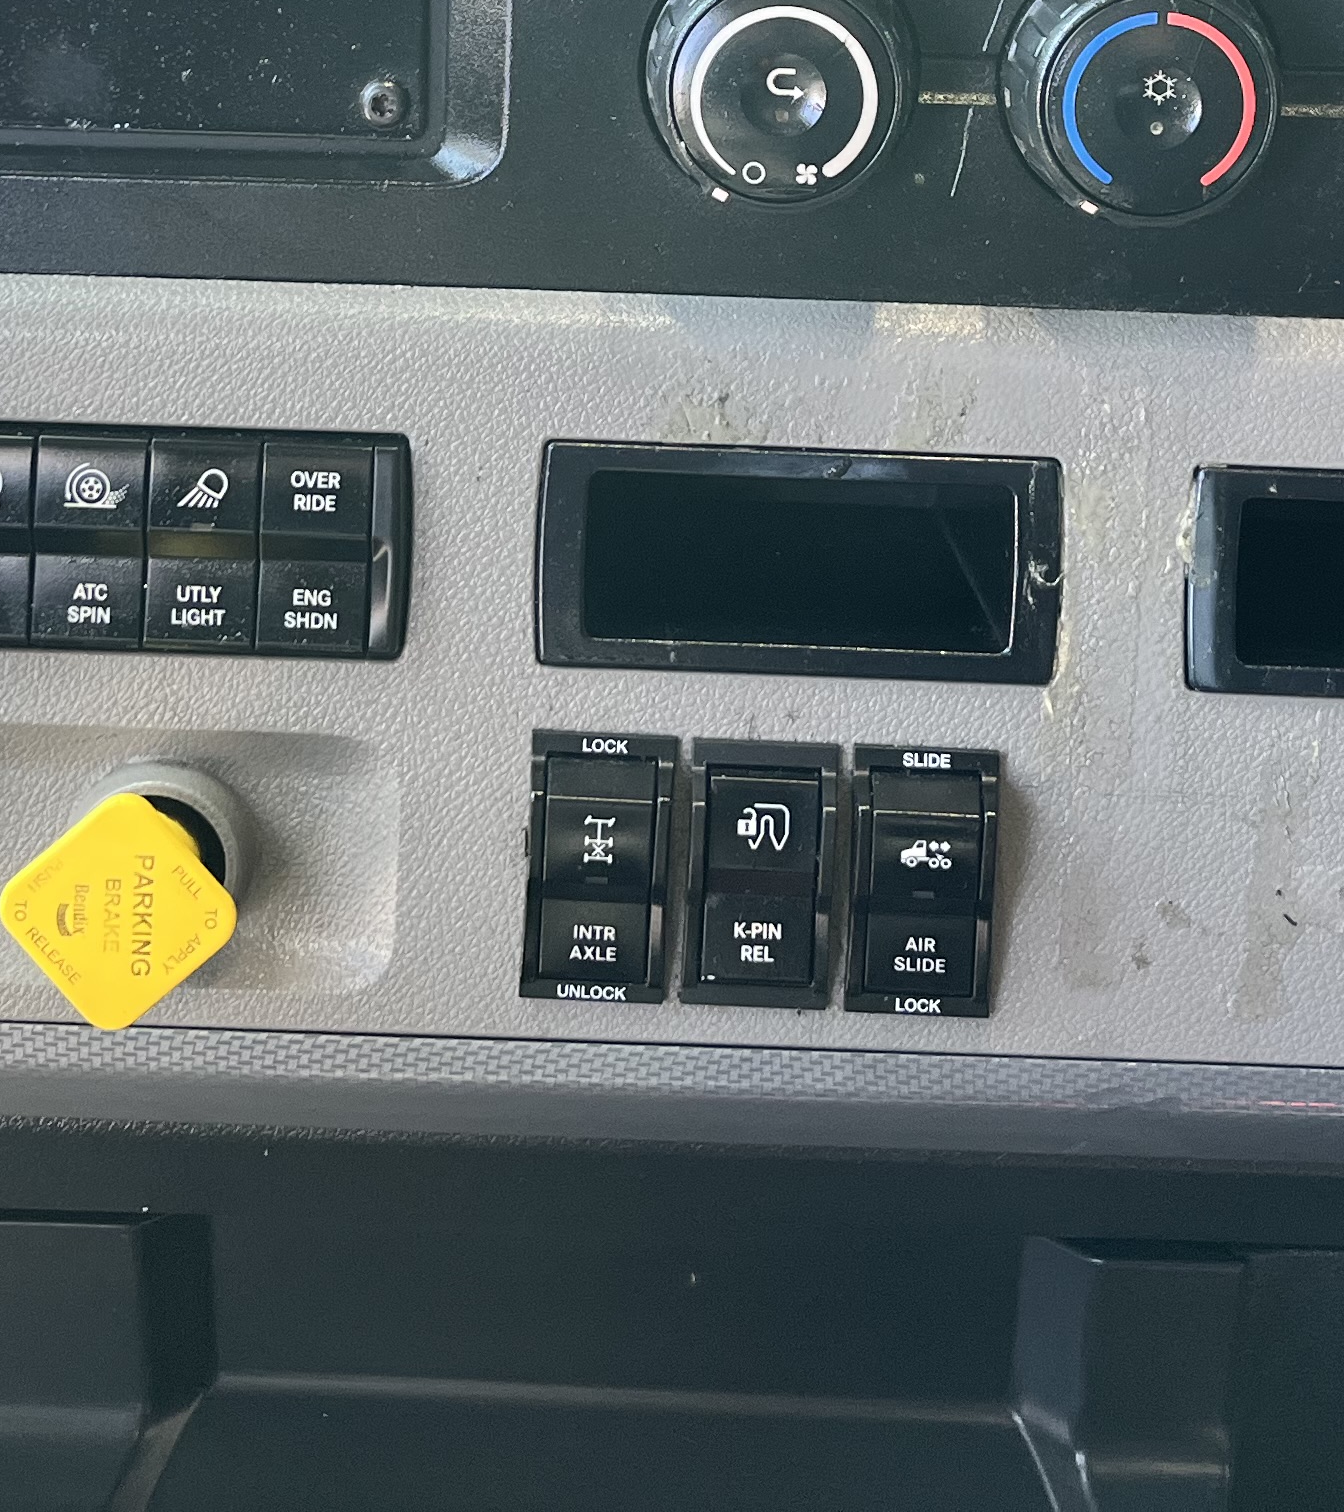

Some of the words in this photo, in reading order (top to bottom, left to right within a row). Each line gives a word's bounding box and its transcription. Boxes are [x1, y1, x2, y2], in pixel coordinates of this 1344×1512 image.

[289, 470, 341, 489] OVER
[293, 494, 337, 513] RIDE
[73, 583, 108, 601] ATC
[176, 585, 223, 604] UTLY
[292, 588, 332, 607] ENG
[67, 606, 111, 624] SPIN
[171, 608, 226, 628] LIGHT
[283, 611, 338, 630] SHDN
[582, 737, 629, 755] LOCK
[902, 752, 952, 770] SLIDE
[171, 864, 202, 901] PULL
[102, 878, 122, 954] BRAKE
[130, 854, 156, 978] PARKING
[204, 907, 218, 931] TO
[572, 924, 617, 942] INTR
[733, 921, 783, 941] K-PIN
[13, 899, 27, 923] TO
[25, 926, 82, 986] RELEASE
[905, 936, 937, 954] AIR
[162, 932, 201, 976] APPLY
[569, 944, 618, 963] AXLE
[740, 944, 775, 963] REL
[894, 955, 947, 974] SLIDE
[557, 984, 627, 1001] UNLOCK
[894, 997, 942, 1014] LOCK
